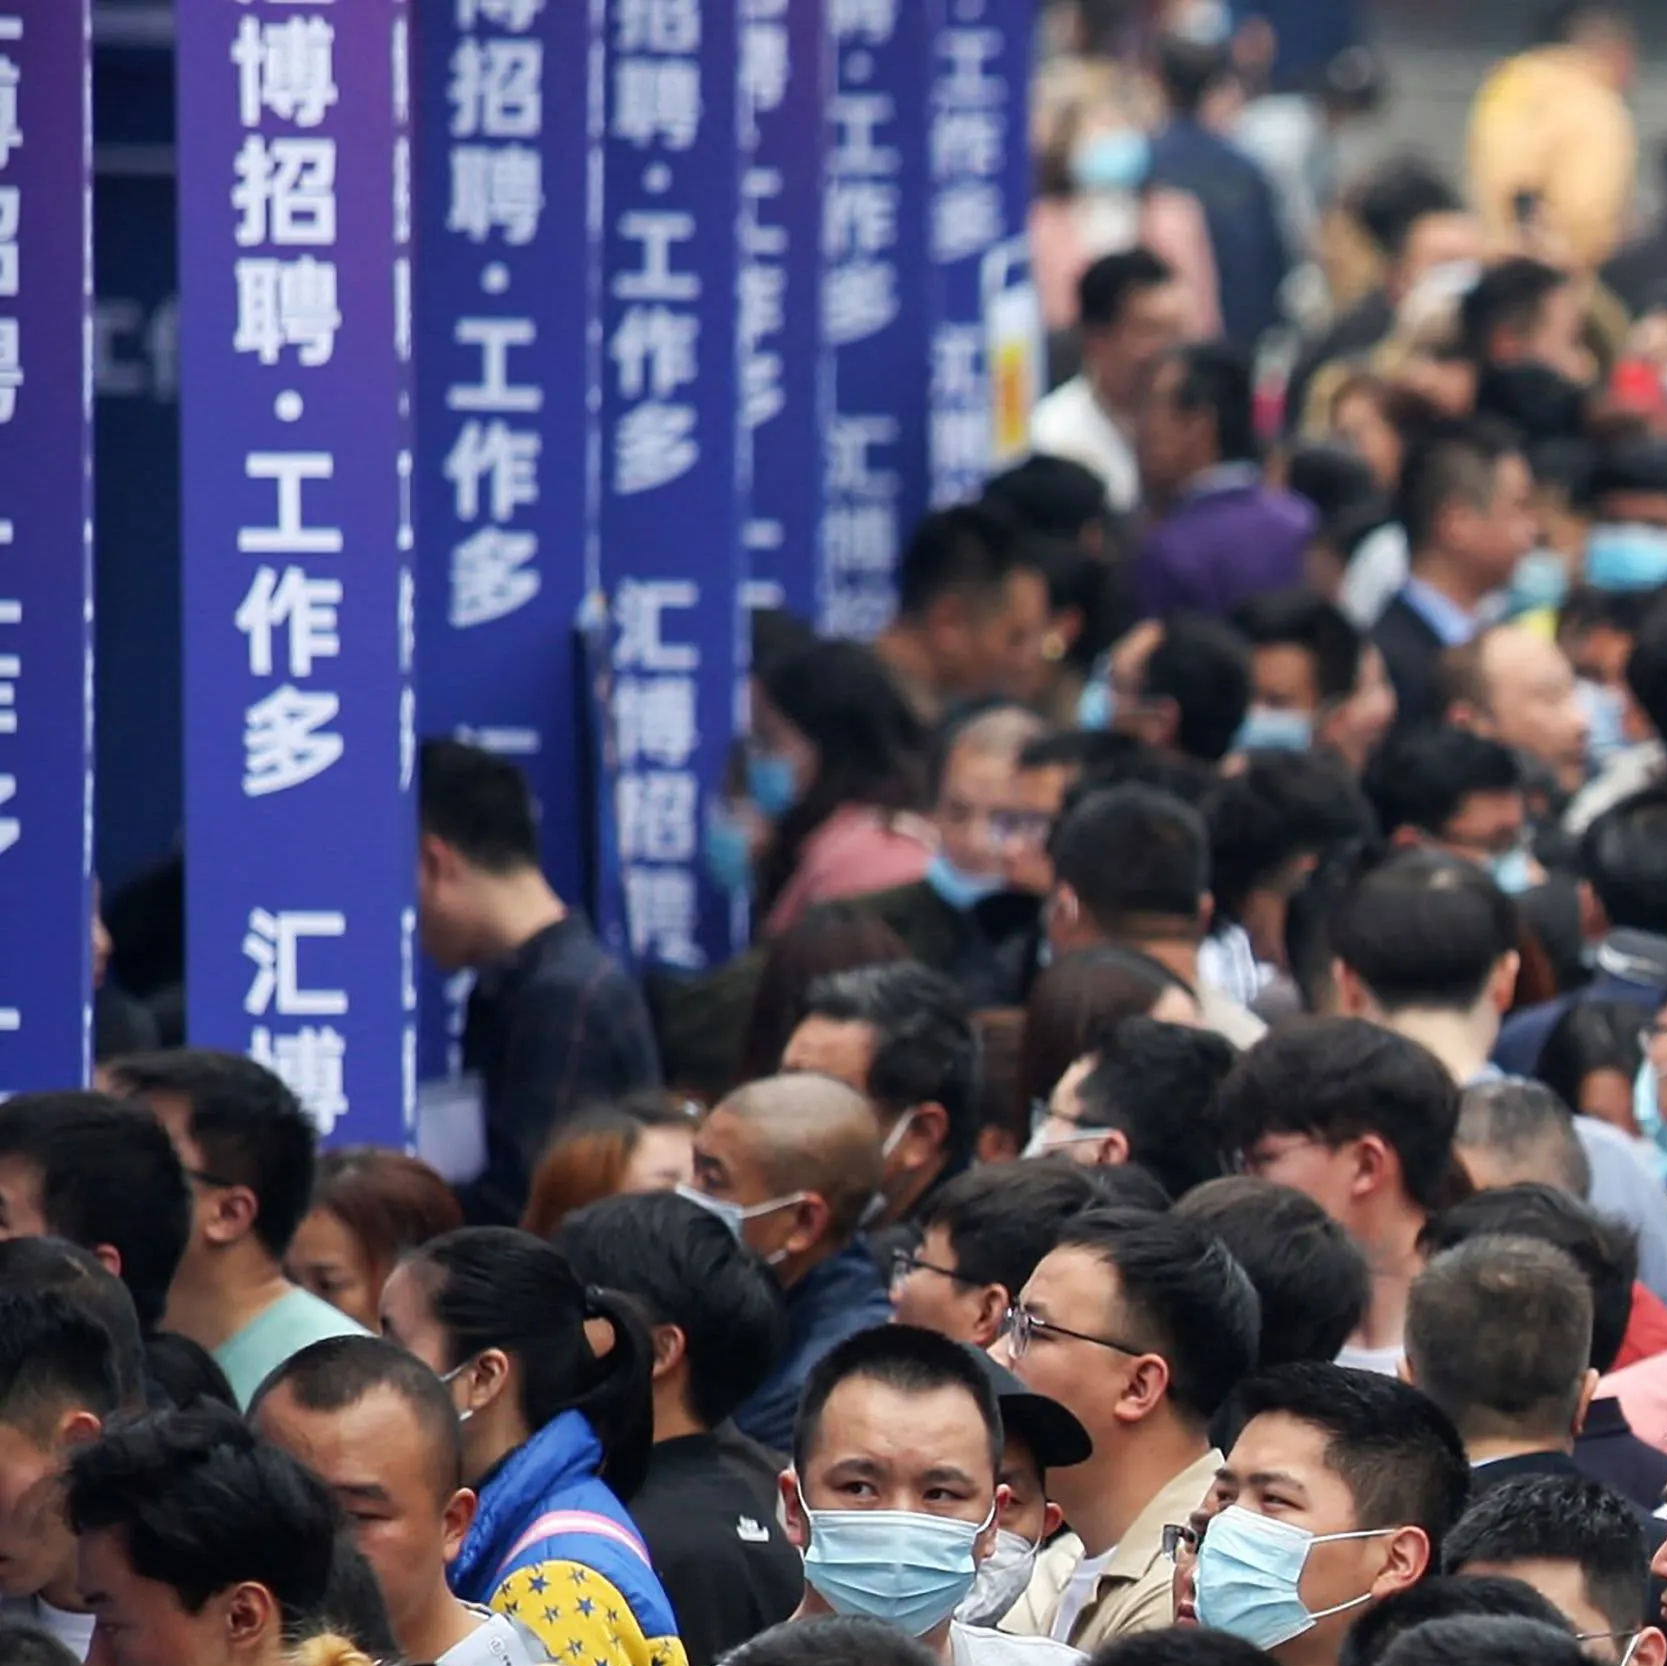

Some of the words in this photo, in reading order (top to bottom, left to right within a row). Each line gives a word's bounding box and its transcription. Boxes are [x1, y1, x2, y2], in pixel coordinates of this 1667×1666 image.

[231, 0, 343, 797] 博招聘·工作多
[243, 908, 348, 1136] 汇博
